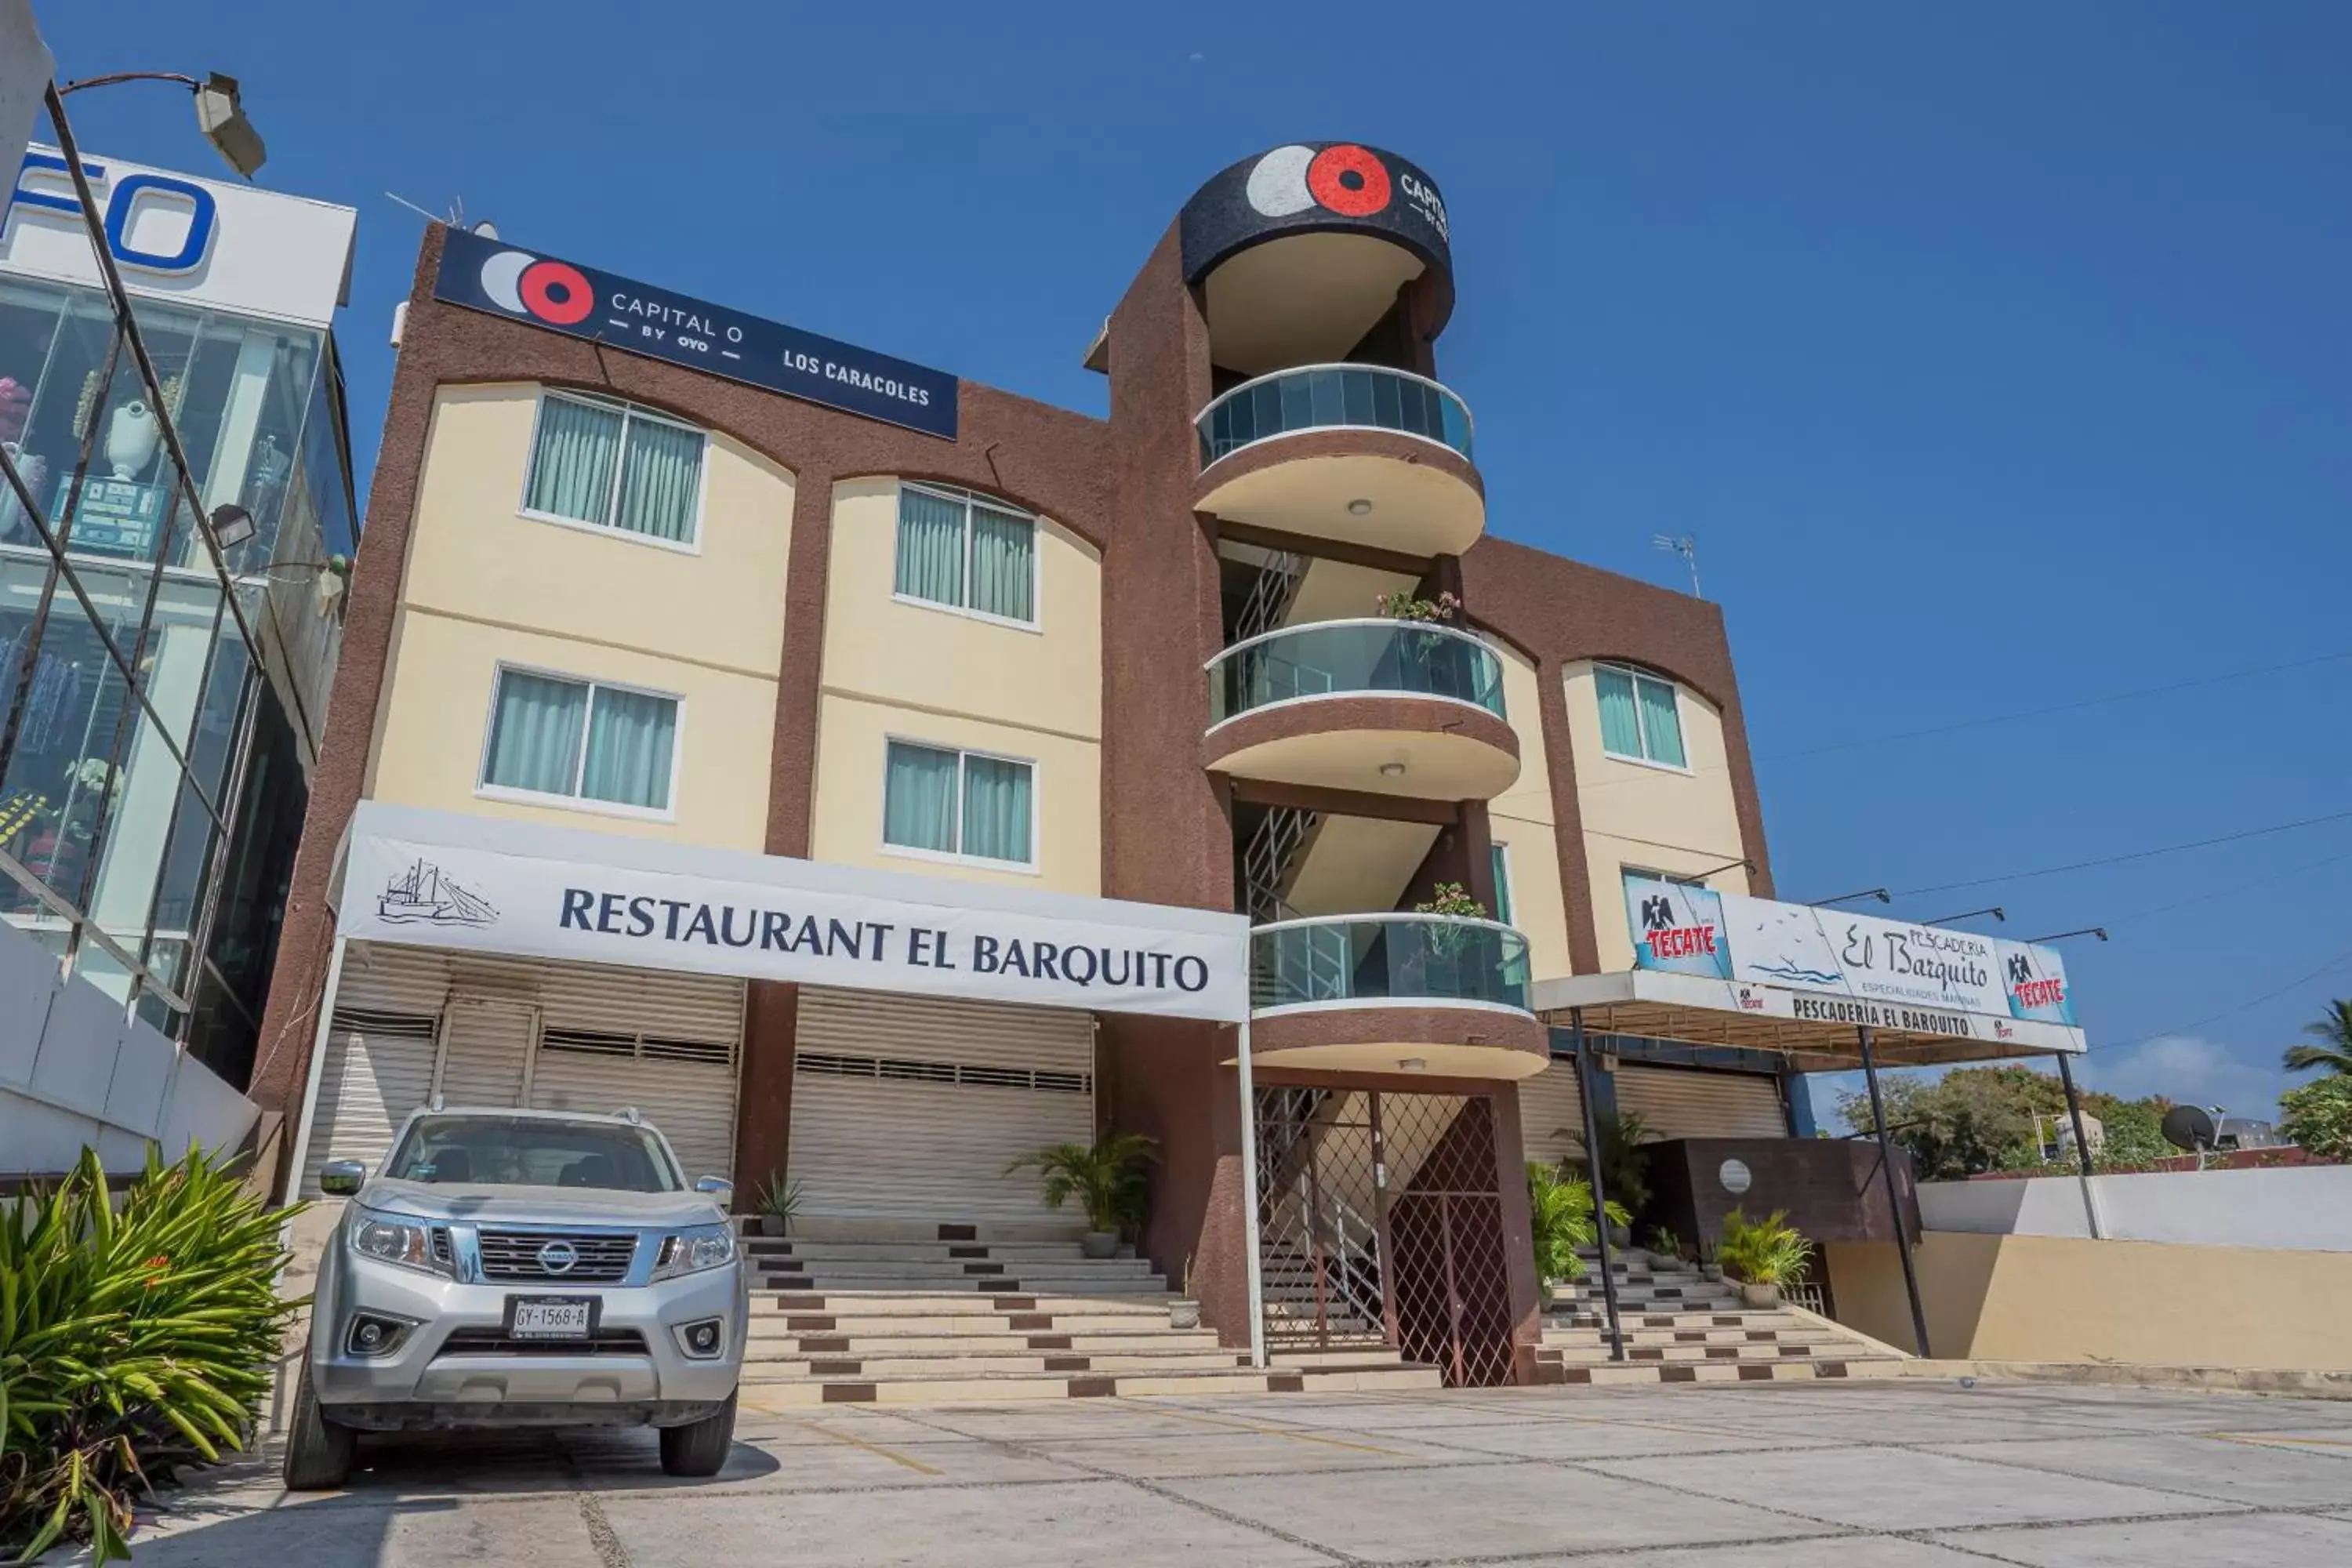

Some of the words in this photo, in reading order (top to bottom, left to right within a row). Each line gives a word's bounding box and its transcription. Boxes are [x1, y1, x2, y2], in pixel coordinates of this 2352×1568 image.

[612, 293, 716, 336] CAPITAL
[727, 326, 742, 343] O
[641, 325, 665, 339] BY
[784, 350, 819, 374] LOS
[826, 361, 928, 406] CARACOLES
[559, 887, 895, 961] RESTAURANT
[907, 927, 956, 970] EL
[972, 935, 1208, 992] BARQUITO
[1646, 925, 1716, 959] TECATE
[1843, 924, 1874, 970] El
[1882, 931, 1987, 991] Barquito
[2014, 978, 2065, 1009] TECATE
[1883, 1007, 1898, 1027] EL
[1902, 1010, 1969, 1036] BARQUITO
